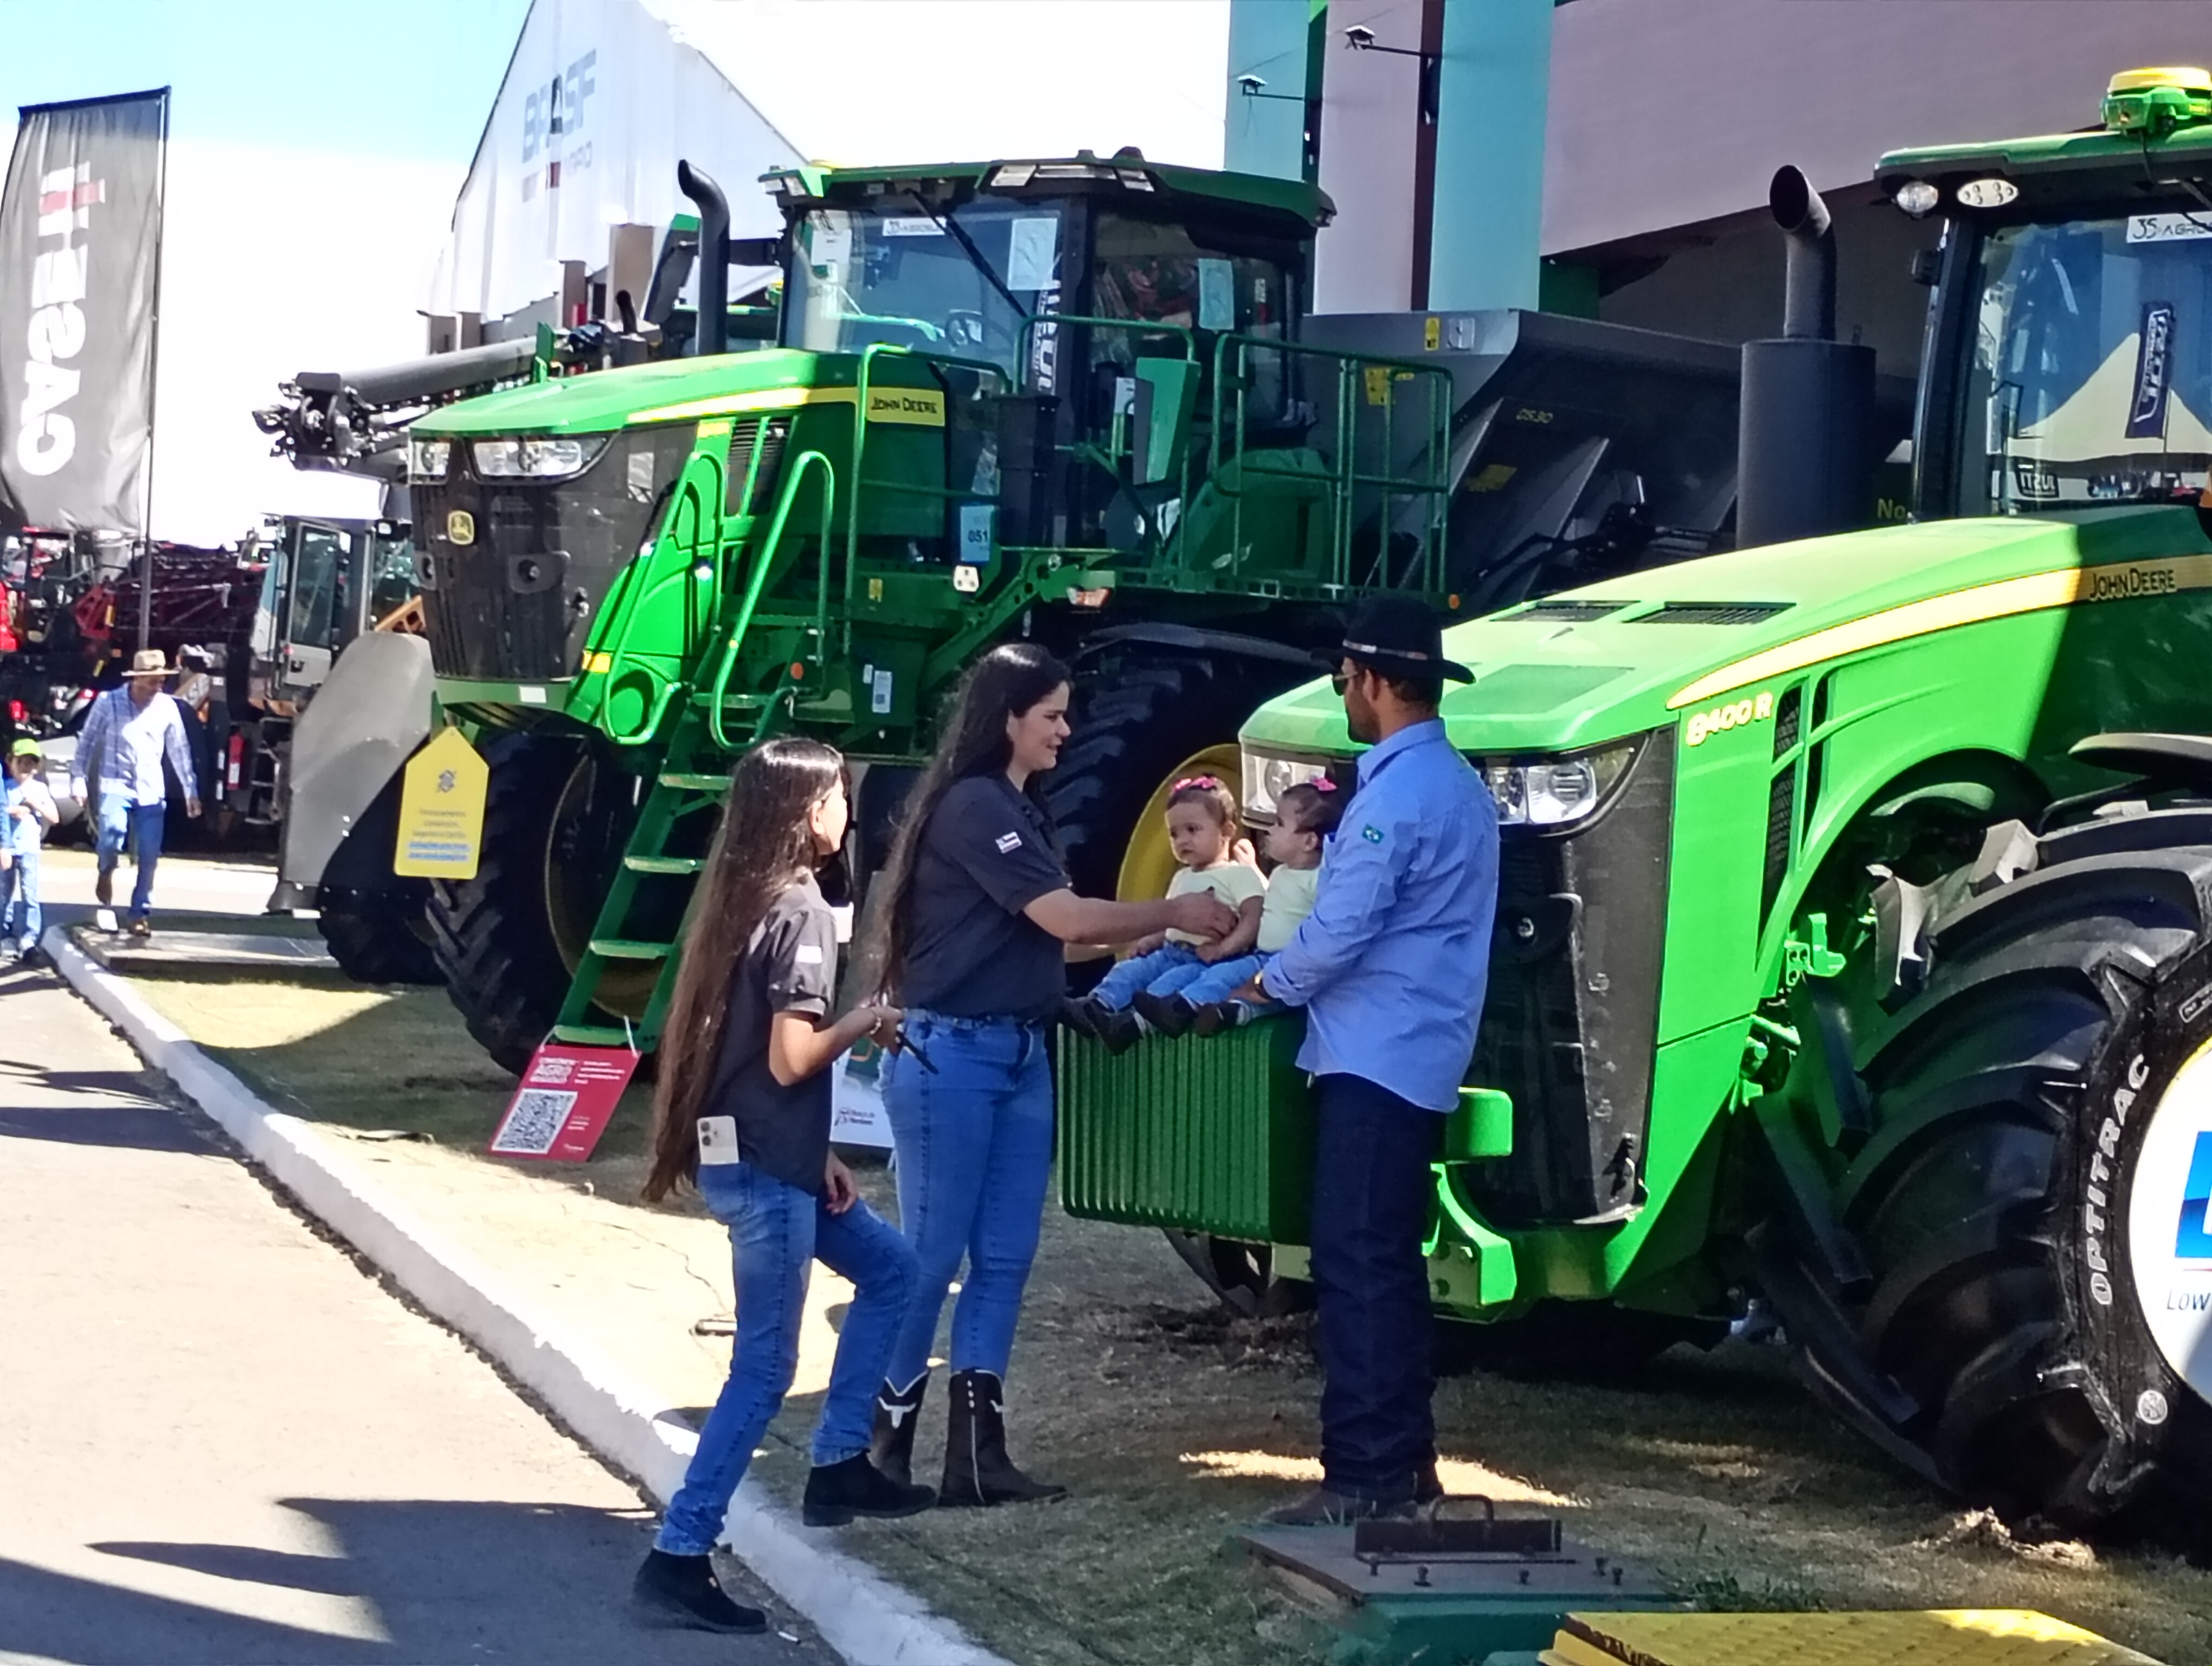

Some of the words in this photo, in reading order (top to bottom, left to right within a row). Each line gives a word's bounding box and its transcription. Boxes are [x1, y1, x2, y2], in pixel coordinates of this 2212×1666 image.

[2089, 572, 2129, 599] JOHN
[2129, 567, 2176, 593] DEERE
[1686, 699, 1753, 746] 8400
[1755, 691, 1773, 722] R
[2086, 1054, 2149, 1306] OPTITRAC
